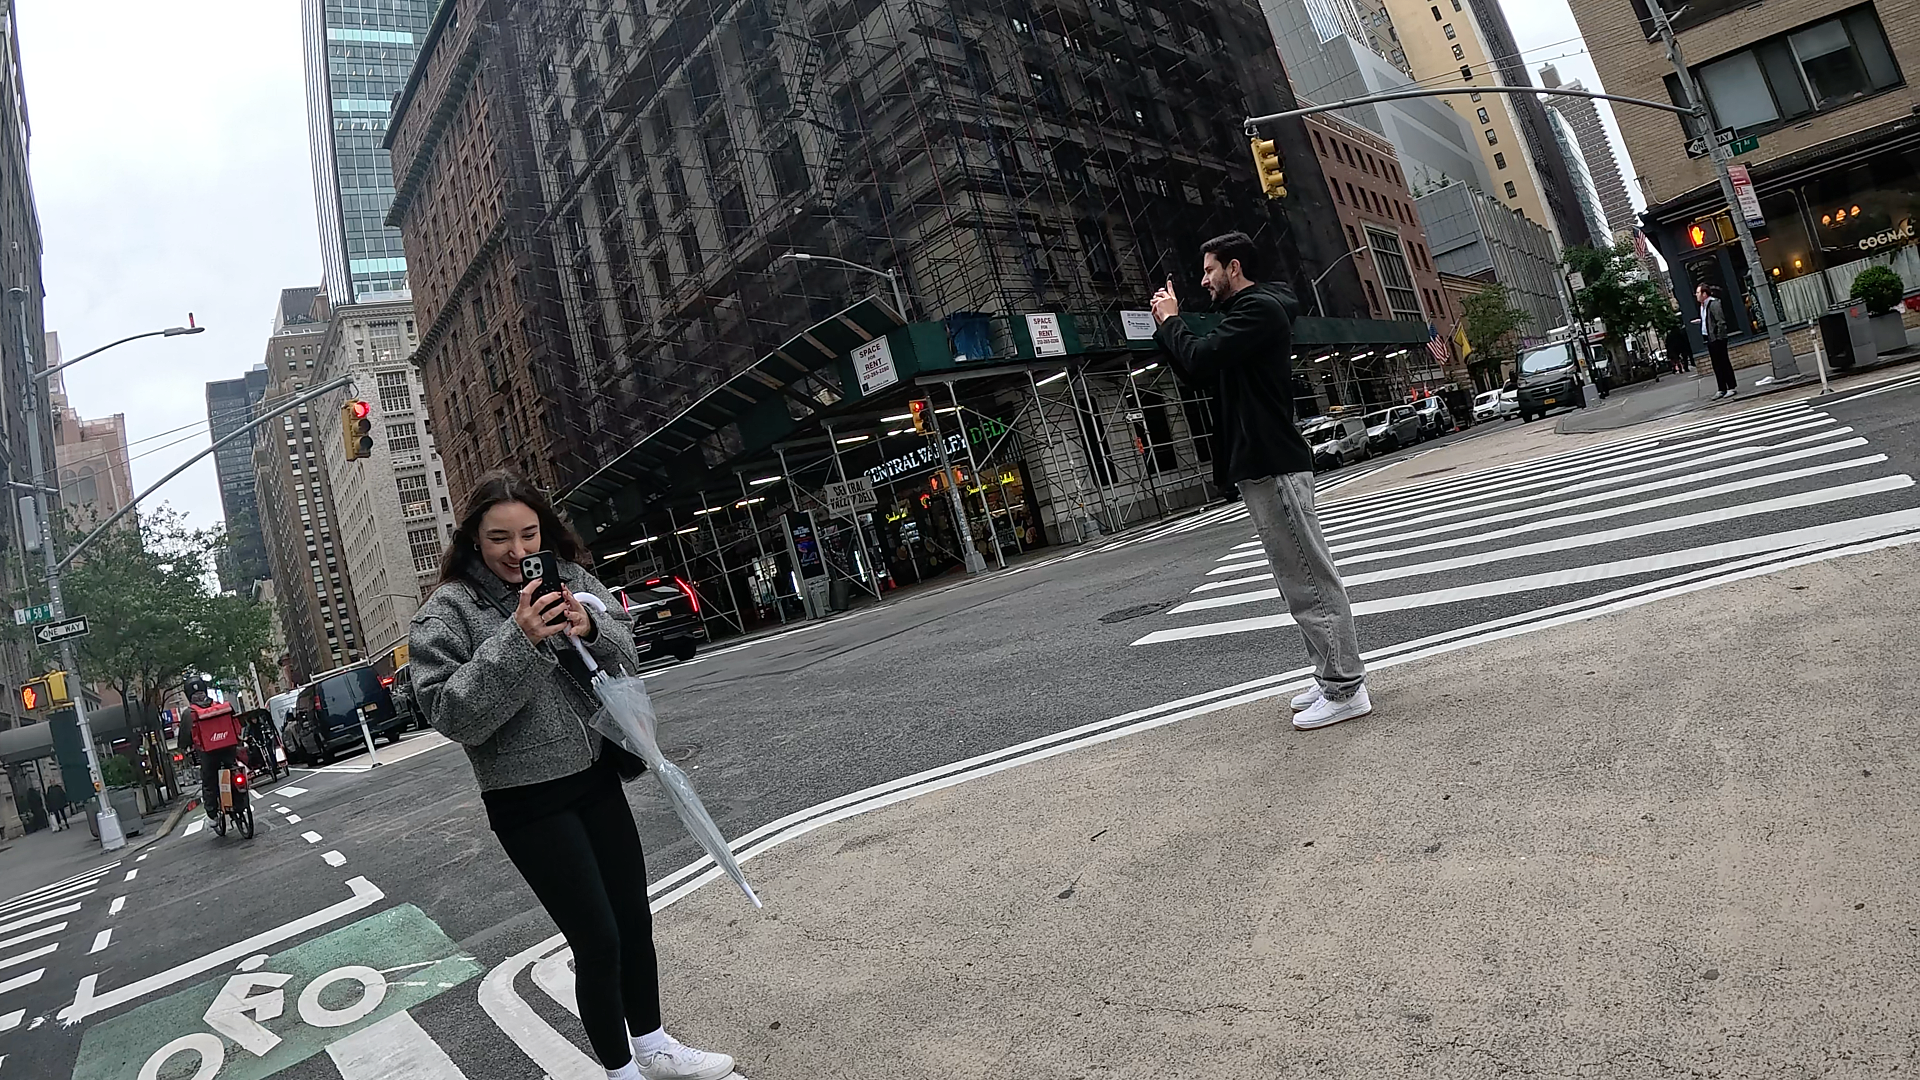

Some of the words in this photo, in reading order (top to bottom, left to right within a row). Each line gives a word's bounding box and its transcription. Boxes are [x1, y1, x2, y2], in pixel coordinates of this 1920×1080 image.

[1693, 141, 1707, 151] ONE
[1736, 142, 1742, 152] 7
[1859, 225, 1915, 250] COGNAC
[859, 343, 881, 358] SPACE
[865, 358, 882, 371] RENT
[864, 452, 920, 484] CENTRAL
[917, 434, 967, 463] VALLEY
[970, 416, 1005, 444] DELI
[858, 490, 875, 504] DELI
[25, 609, 31, 621] W
[33, 607, 43, 619] 58
[43, 628, 58, 638] ONE
[65, 623, 80, 633] WAY
